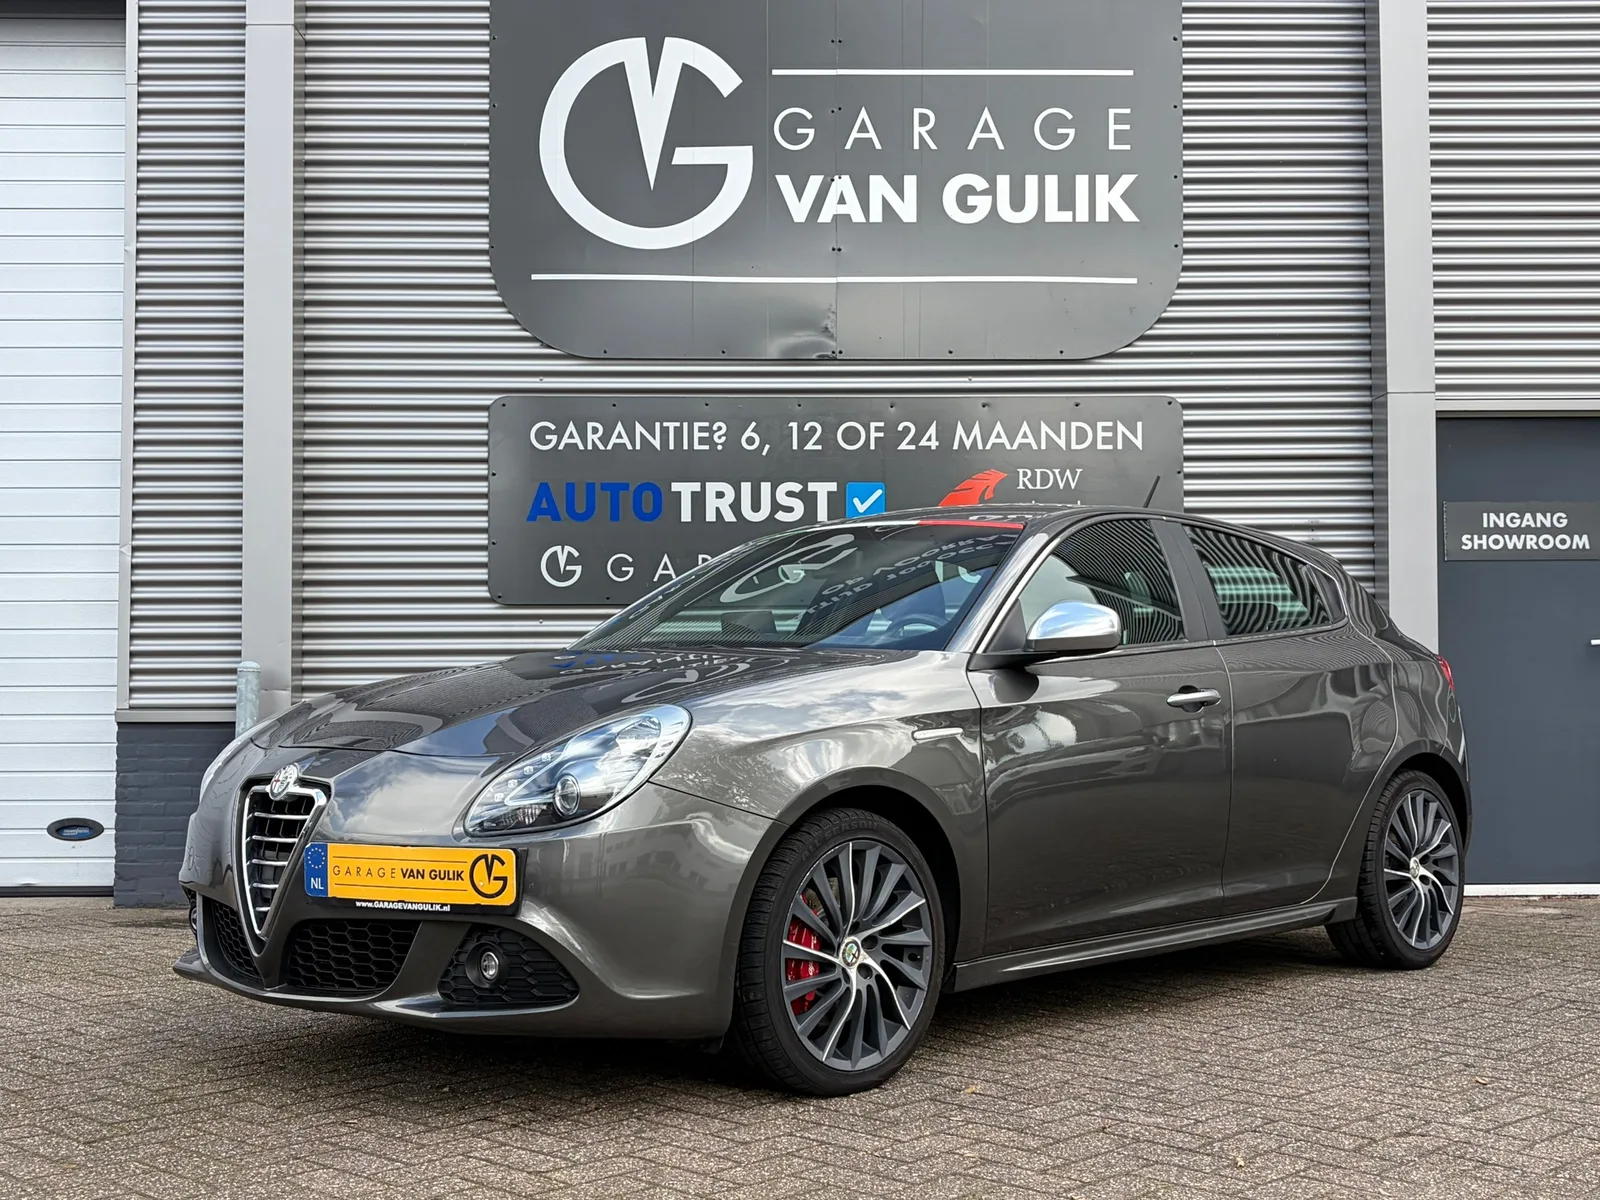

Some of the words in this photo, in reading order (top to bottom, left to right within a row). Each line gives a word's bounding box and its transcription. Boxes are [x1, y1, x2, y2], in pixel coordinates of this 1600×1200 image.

[773, 107, 1132, 151] GARAGE
[775, 174, 918, 224] VAN
[941, 173, 1140, 224] GULIK
[529, 421, 727, 451] GARANTIE?
[740, 421, 771, 456] 6,
[788, 421, 822, 451] 12
[836, 421, 885, 451] OF
[897, 420, 939, 451] 24
[953, 420, 1143, 451] MAANDEN
[1016, 468, 1083, 490] RDW
[1482, 512, 1568, 528] INGANG
[1461, 534, 1591, 550] SHOWROOM
[333, 865, 396, 879] GARAGE
[400, 868, 424, 880] VAN
[429, 869, 464, 881] GULIK
[310, 877, 324, 890] NL
[355, 900, 450, 912] www.GARAGEVANGULIK.nl
